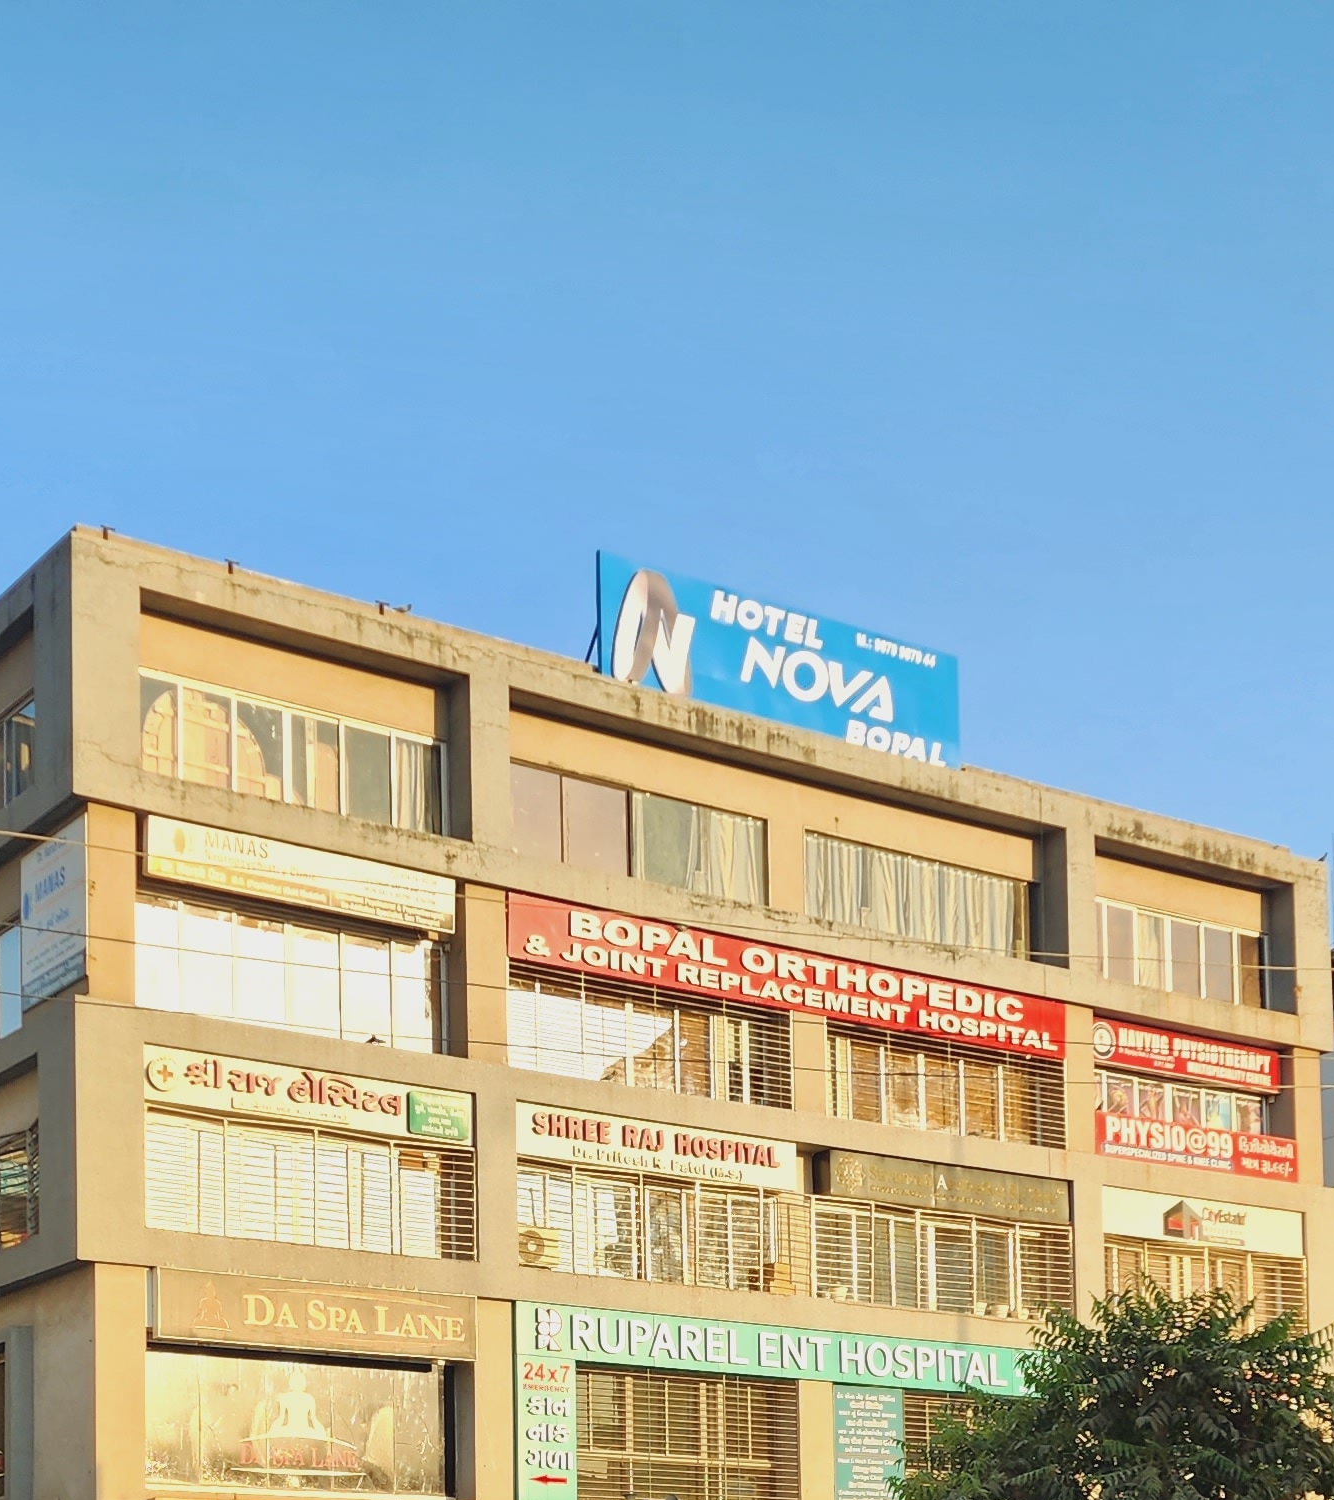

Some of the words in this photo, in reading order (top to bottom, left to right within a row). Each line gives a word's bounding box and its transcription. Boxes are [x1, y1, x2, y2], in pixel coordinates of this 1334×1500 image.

[710, 589, 823, 649] HOTEL
[740, 636, 894, 723] NOVA
[845, 720, 946, 767] BOPAL
[204, 832, 270, 859] MANAS
[569, 910, 730, 969] BOPAL
[740, 945, 1026, 1023] ORTHOPEDIC
[525, 933, 551, 957] &
[562, 941, 668, 978] JOINT
[678, 964, 911, 1025] REPLACEMENT
[918, 1009, 1059, 1053] HOSPITAL
[1172, 1037, 1272, 1074] PHYSIOTHERAPY
[182, 1058, 223, 1089] શ્રી
[228, 1068, 281, 1097] રાજ
[287, 1071, 403, 1116] હોસ્પિટલ
[531, 1111, 611, 1145] SHREE
[622, 1125, 665, 1152] RAJ
[674, 1132, 780, 1168] HOSPITAL
[1105, 1115, 1234, 1159] PHYSIO@99
[243, 1294, 298, 1328] DA
[307, 1300, 367, 1334] SPA
[374, 1305, 466, 1342] LANE
[569, 1314, 750, 1366] RUPAREL
[756, 1331, 831, 1372] ENT
[838, 1339, 1009, 1389] HOSPITAL
[522, 1383, 570, 1393] EMERGENCY
[526, 1395, 572, 1417] કાન
[526, 1422, 571, 1444] નાક
[525, 1448, 574, 1471] ગળા
